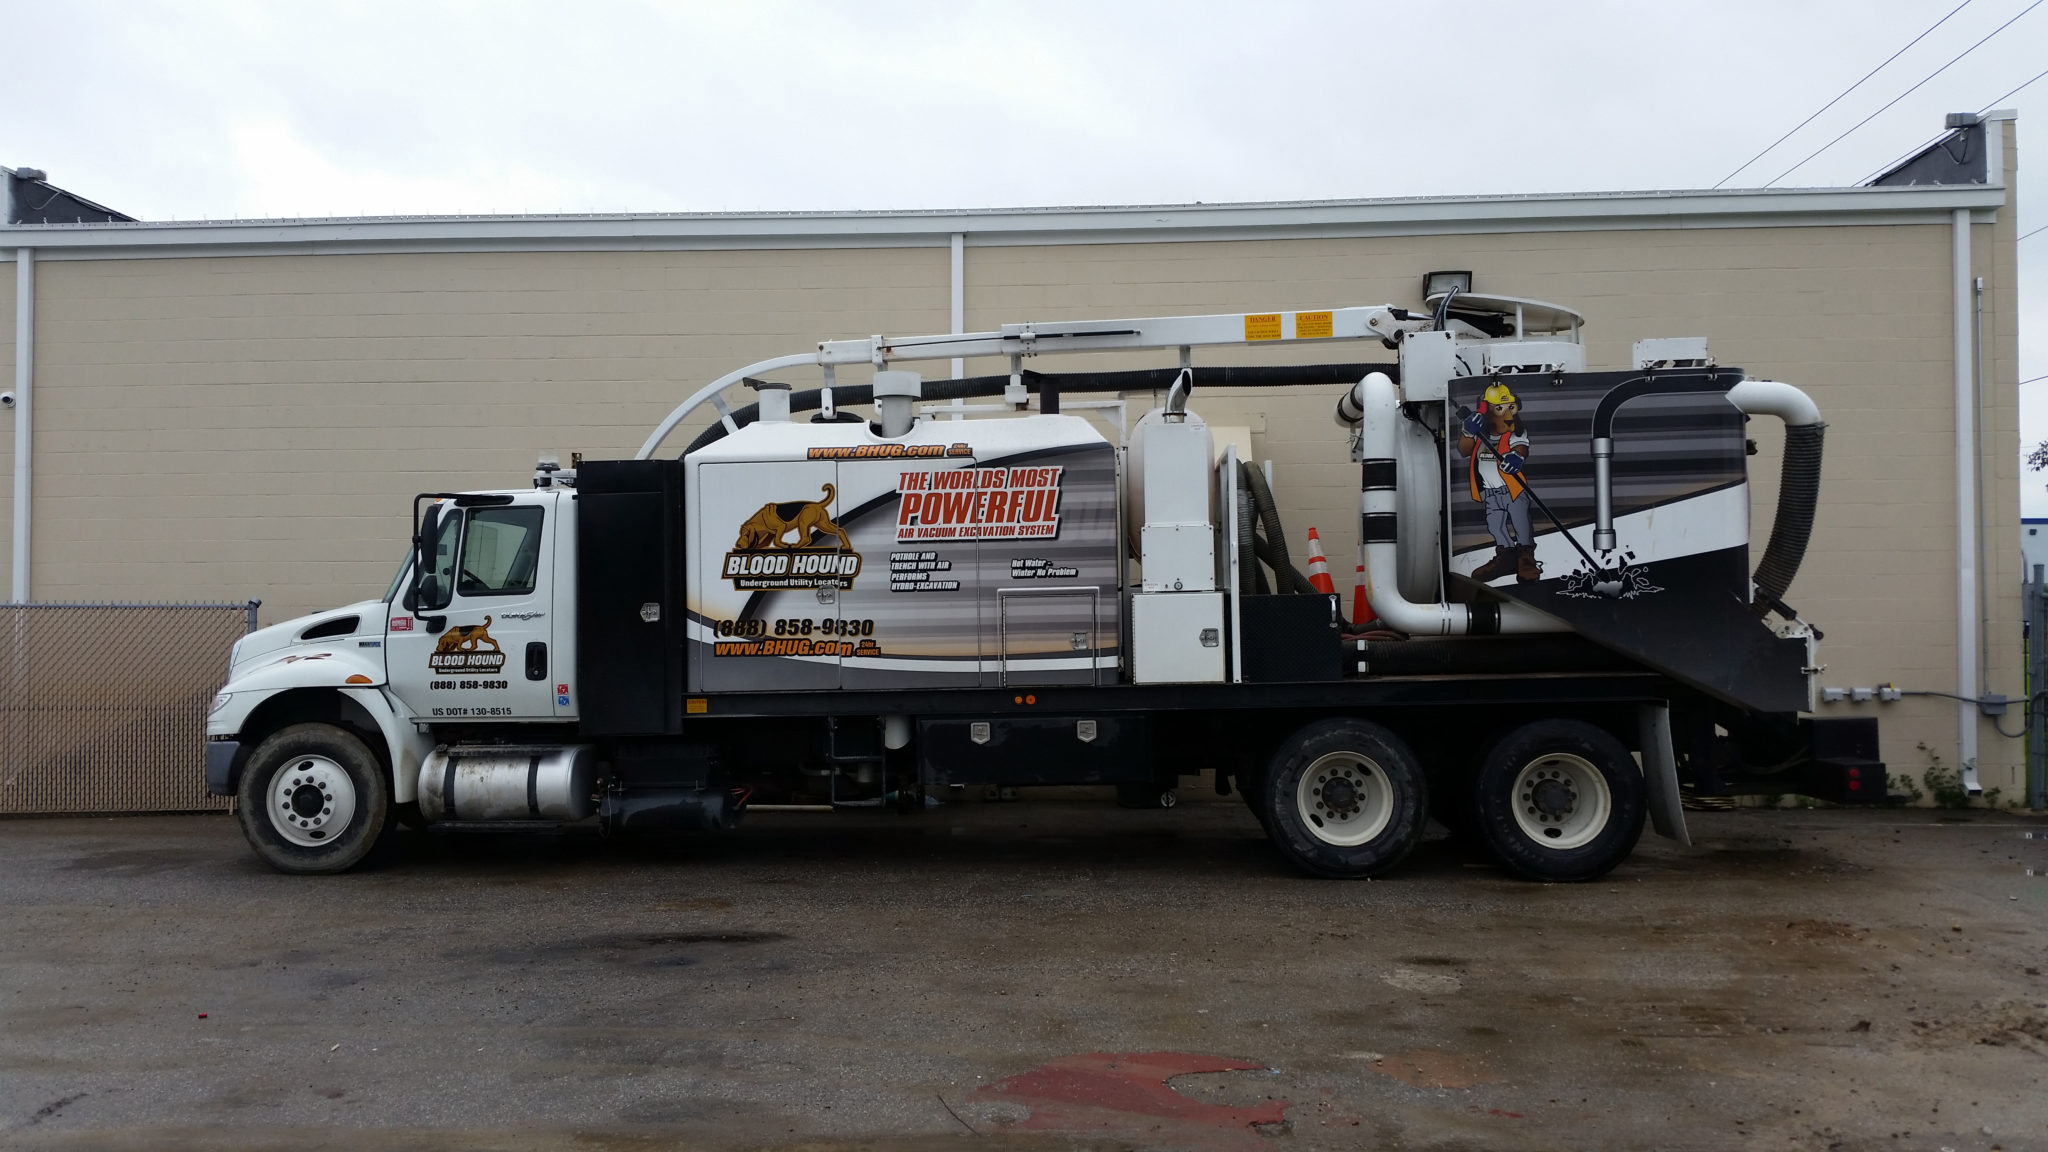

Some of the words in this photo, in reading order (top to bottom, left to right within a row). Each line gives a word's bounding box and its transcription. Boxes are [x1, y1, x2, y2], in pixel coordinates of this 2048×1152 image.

[808, 445, 945, 458] www.BHUG.com
[899, 472, 929, 490] THE
[933, 470, 1005, 489] WORLDS
[1009, 468, 1059, 488] MOST
[899, 490, 1057, 525] POWERFUL
[898, 527, 914, 538] AIR
[917, 527, 957, 538] VACUUM
[959, 526, 1016, 537] EXCAVATION
[1018, 525, 1054, 536] SYSTEM
[891, 552, 920, 561] POTHOLE
[920, 552, 936, 560] AND
[726, 555, 789, 575] BLOOD
[791, 554, 858, 575] HOUND
[891, 562, 917, 570] TRENCH
[918, 561, 936, 570] WITH
[936, 561, 950, 569] AIR
[1011, 559, 1024, 568] Hot
[1025, 559, 1047, 567] Water
[891, 572, 928, 581] PERFORMS
[1047, 567, 1077, 576] Problem
[740, 579, 789, 588] Underground
[790, 578, 813, 587] Utility
[814, 578, 848, 587] Locators
[891, 581, 958, 590] HYDRO-EXCAVATION
[713, 619, 767, 639] (888)
[774, 618, 874, 637] 858-9830
[715, 640, 853, 657] www.BHUG.com
[431, 655, 465, 666] BLOOD
[467, 654, 504, 666] HOUND
[430, 680, 456, 690] (888)
[459, 680, 508, 690] 858-9830
[432, 707, 444, 716] US
[446, 707, 468, 716] DOT#
[470, 707, 512, 716] 130-8515
